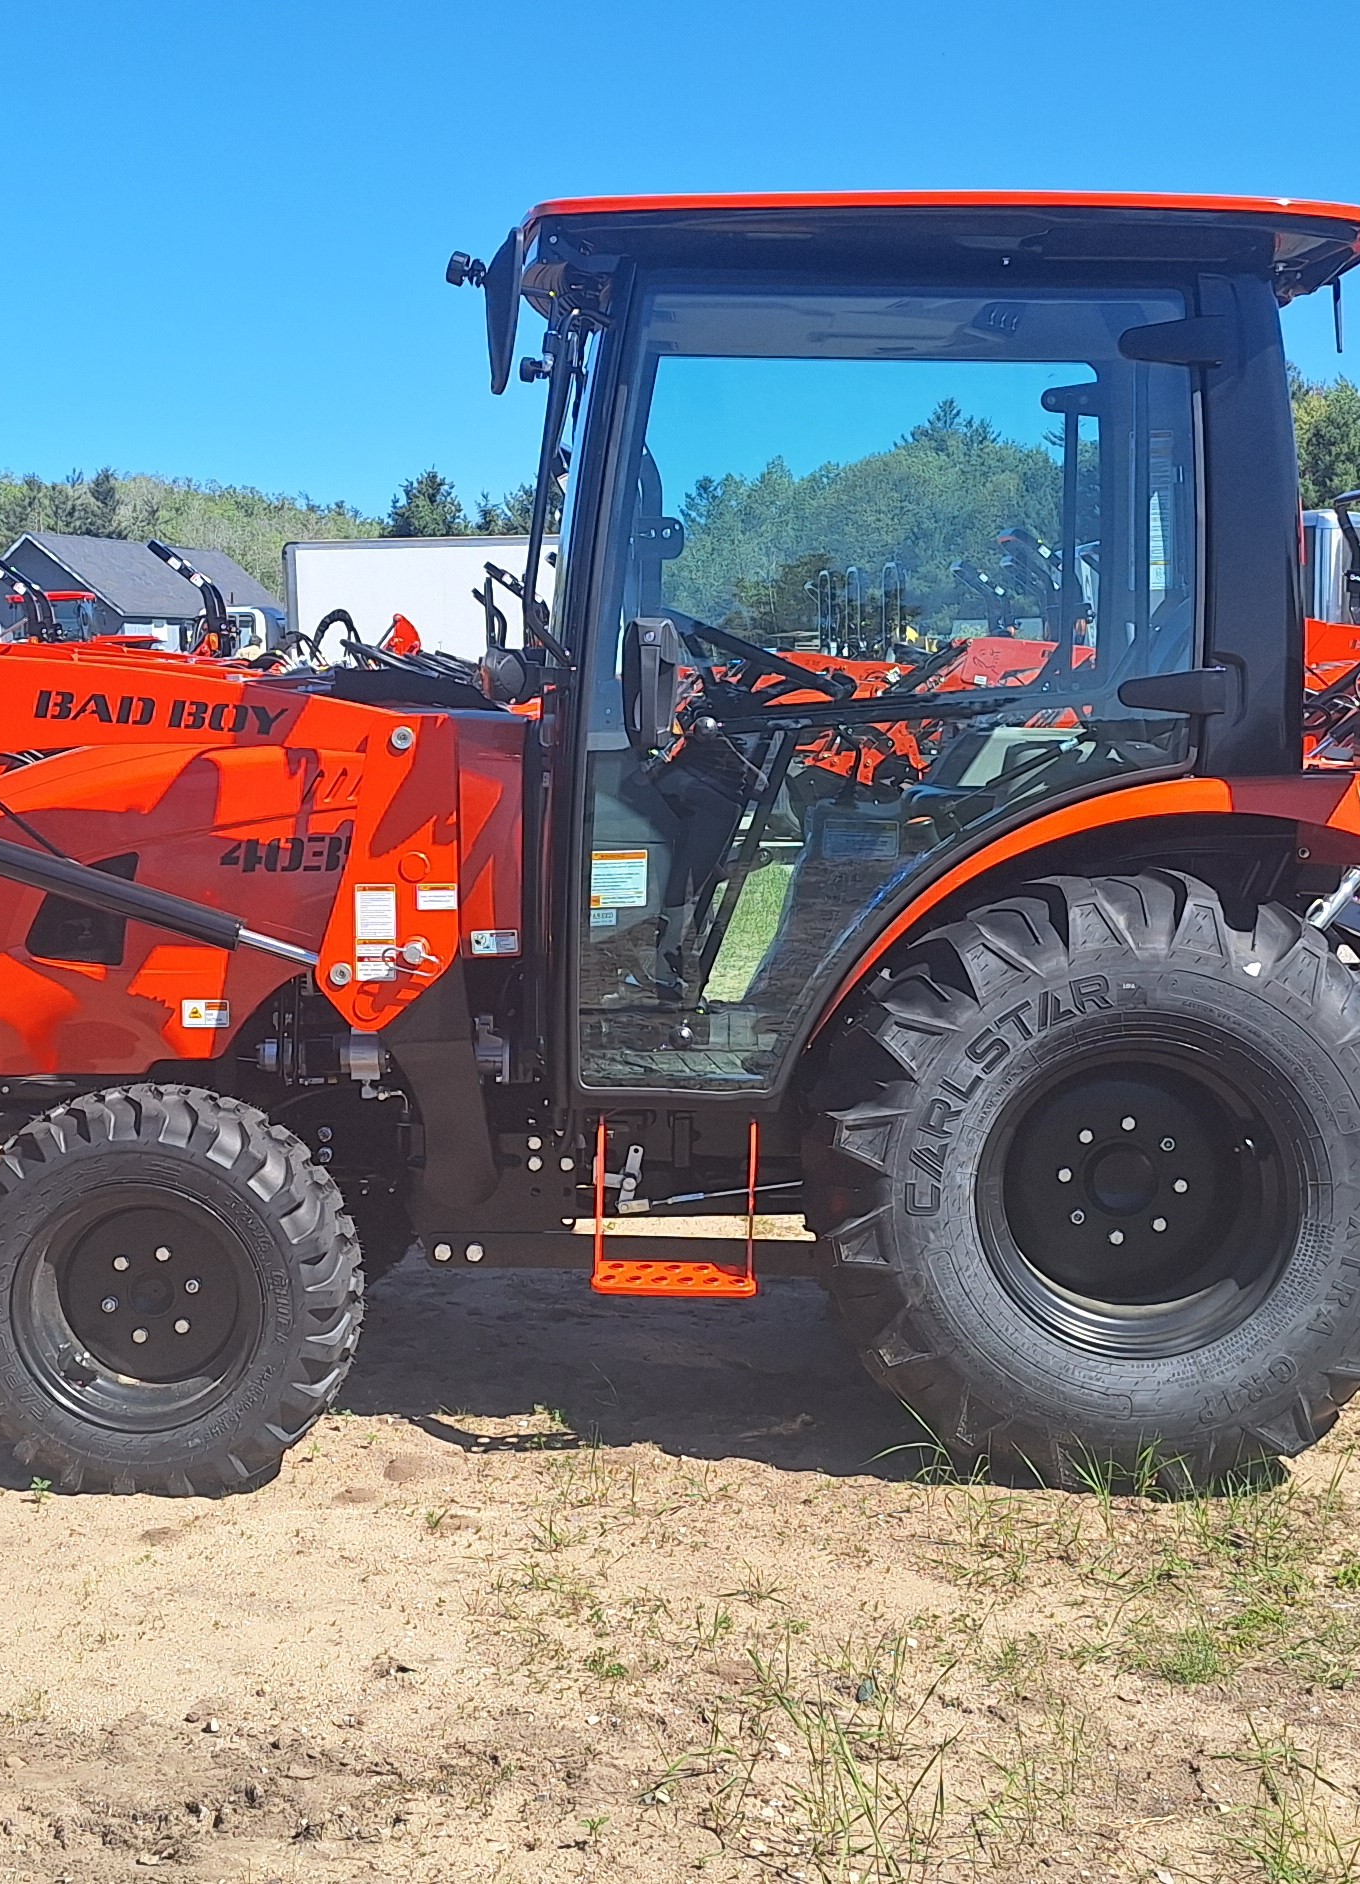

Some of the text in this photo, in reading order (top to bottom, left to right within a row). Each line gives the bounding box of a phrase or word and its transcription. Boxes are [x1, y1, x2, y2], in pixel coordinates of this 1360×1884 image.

[34, 689, 289, 736] BAD BOY
[219, 835, 353, 873] 403
[905, 973, 1116, 1216] CARLSTAR
[1198, 1353, 1300, 1425] GRIP
